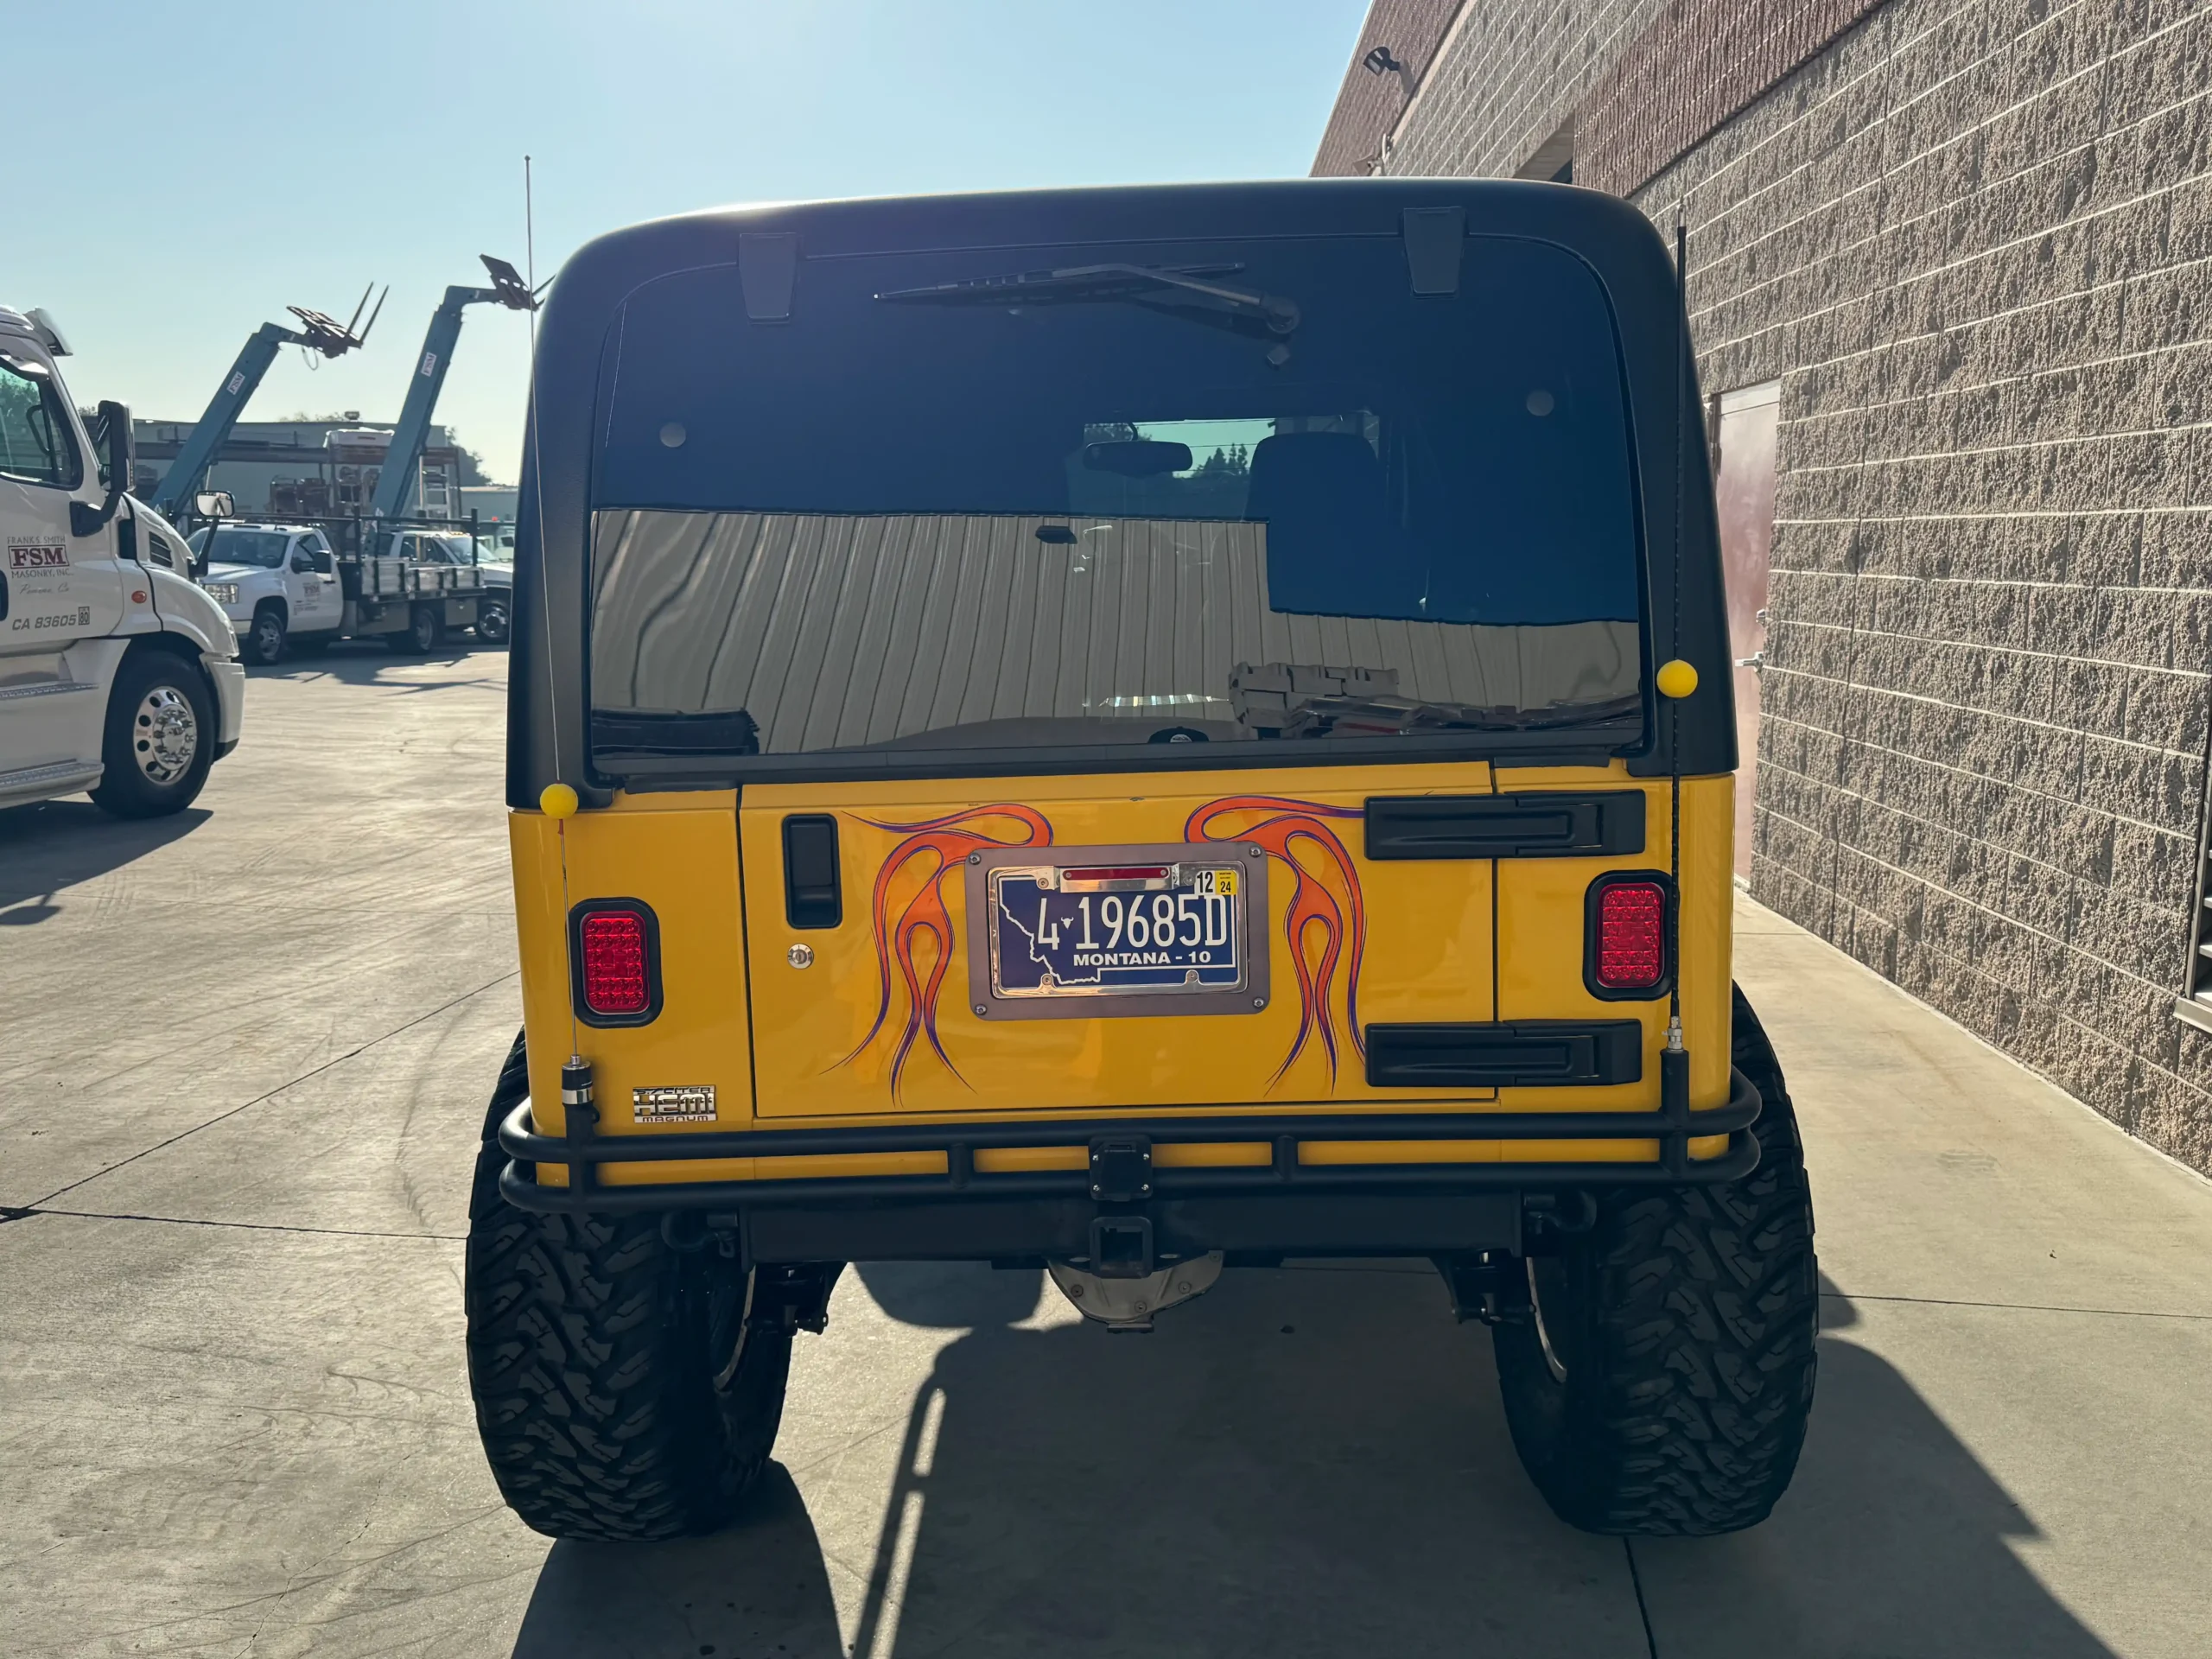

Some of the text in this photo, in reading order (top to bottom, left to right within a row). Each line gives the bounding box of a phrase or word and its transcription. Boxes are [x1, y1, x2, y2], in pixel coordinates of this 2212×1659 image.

[7, 536, 35, 544] FRANK
[44, 535, 66, 543] SMITH
[10, 547, 67, 567] FSM
[12, 613, 77, 631] CA 83605
[1197, 871, 1213, 893] 12
[1220, 880, 1231, 893] 24
[1073, 952, 1171, 966] MONTANA
[1188, 950, 1211, 963] 10
[632, 1093, 715, 1116] HEMI
